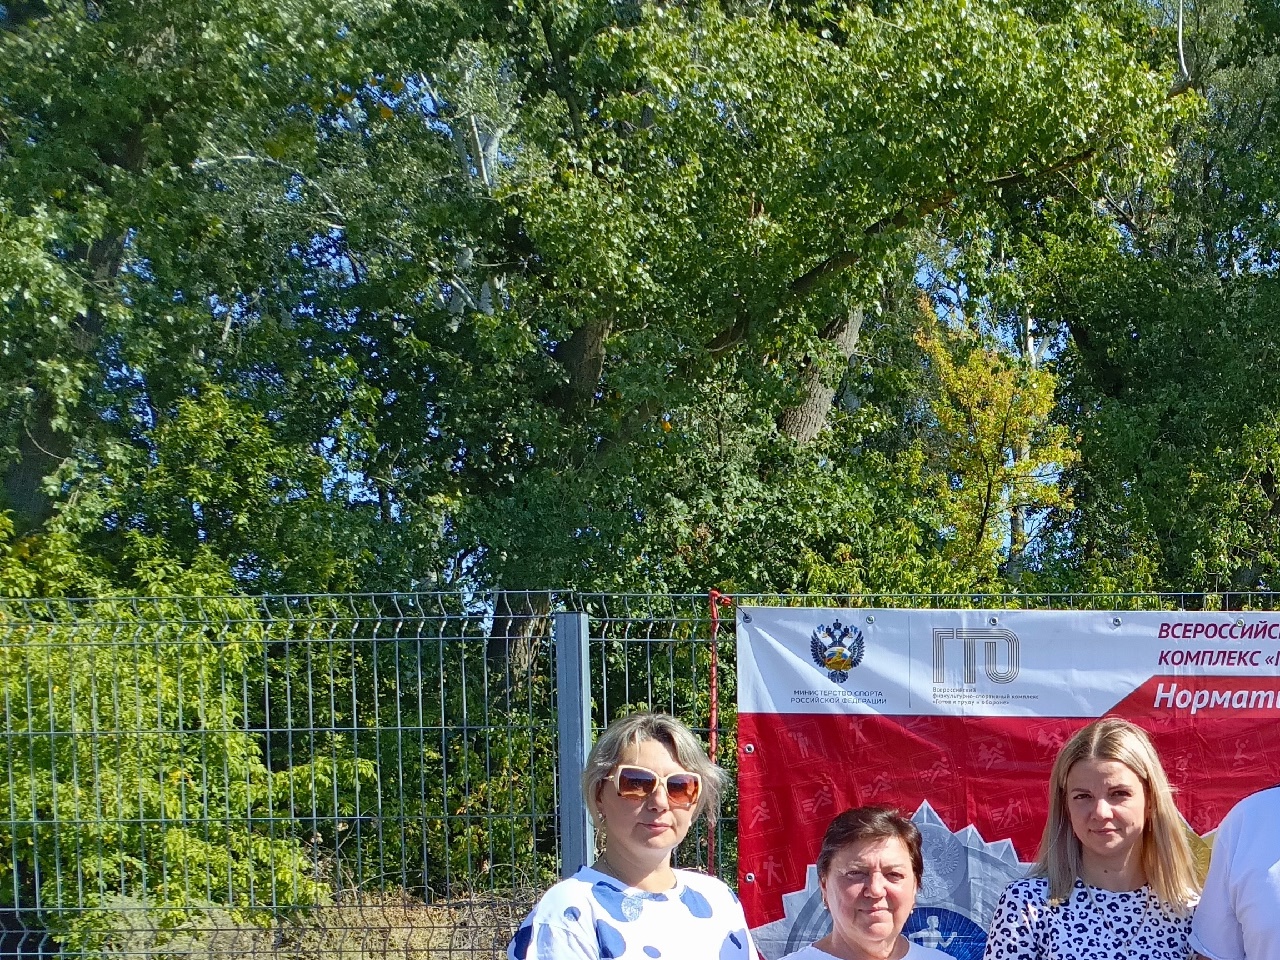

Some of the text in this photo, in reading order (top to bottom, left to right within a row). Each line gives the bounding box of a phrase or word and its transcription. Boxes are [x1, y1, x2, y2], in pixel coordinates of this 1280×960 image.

[932, 627, 1020, 685] ГТО
[1157, 650, 1262, 667] КОМПЛЕКС
[790, 696, 887, 705] РОССИЙСКОЙ ФЕДЕРАЦИИ
